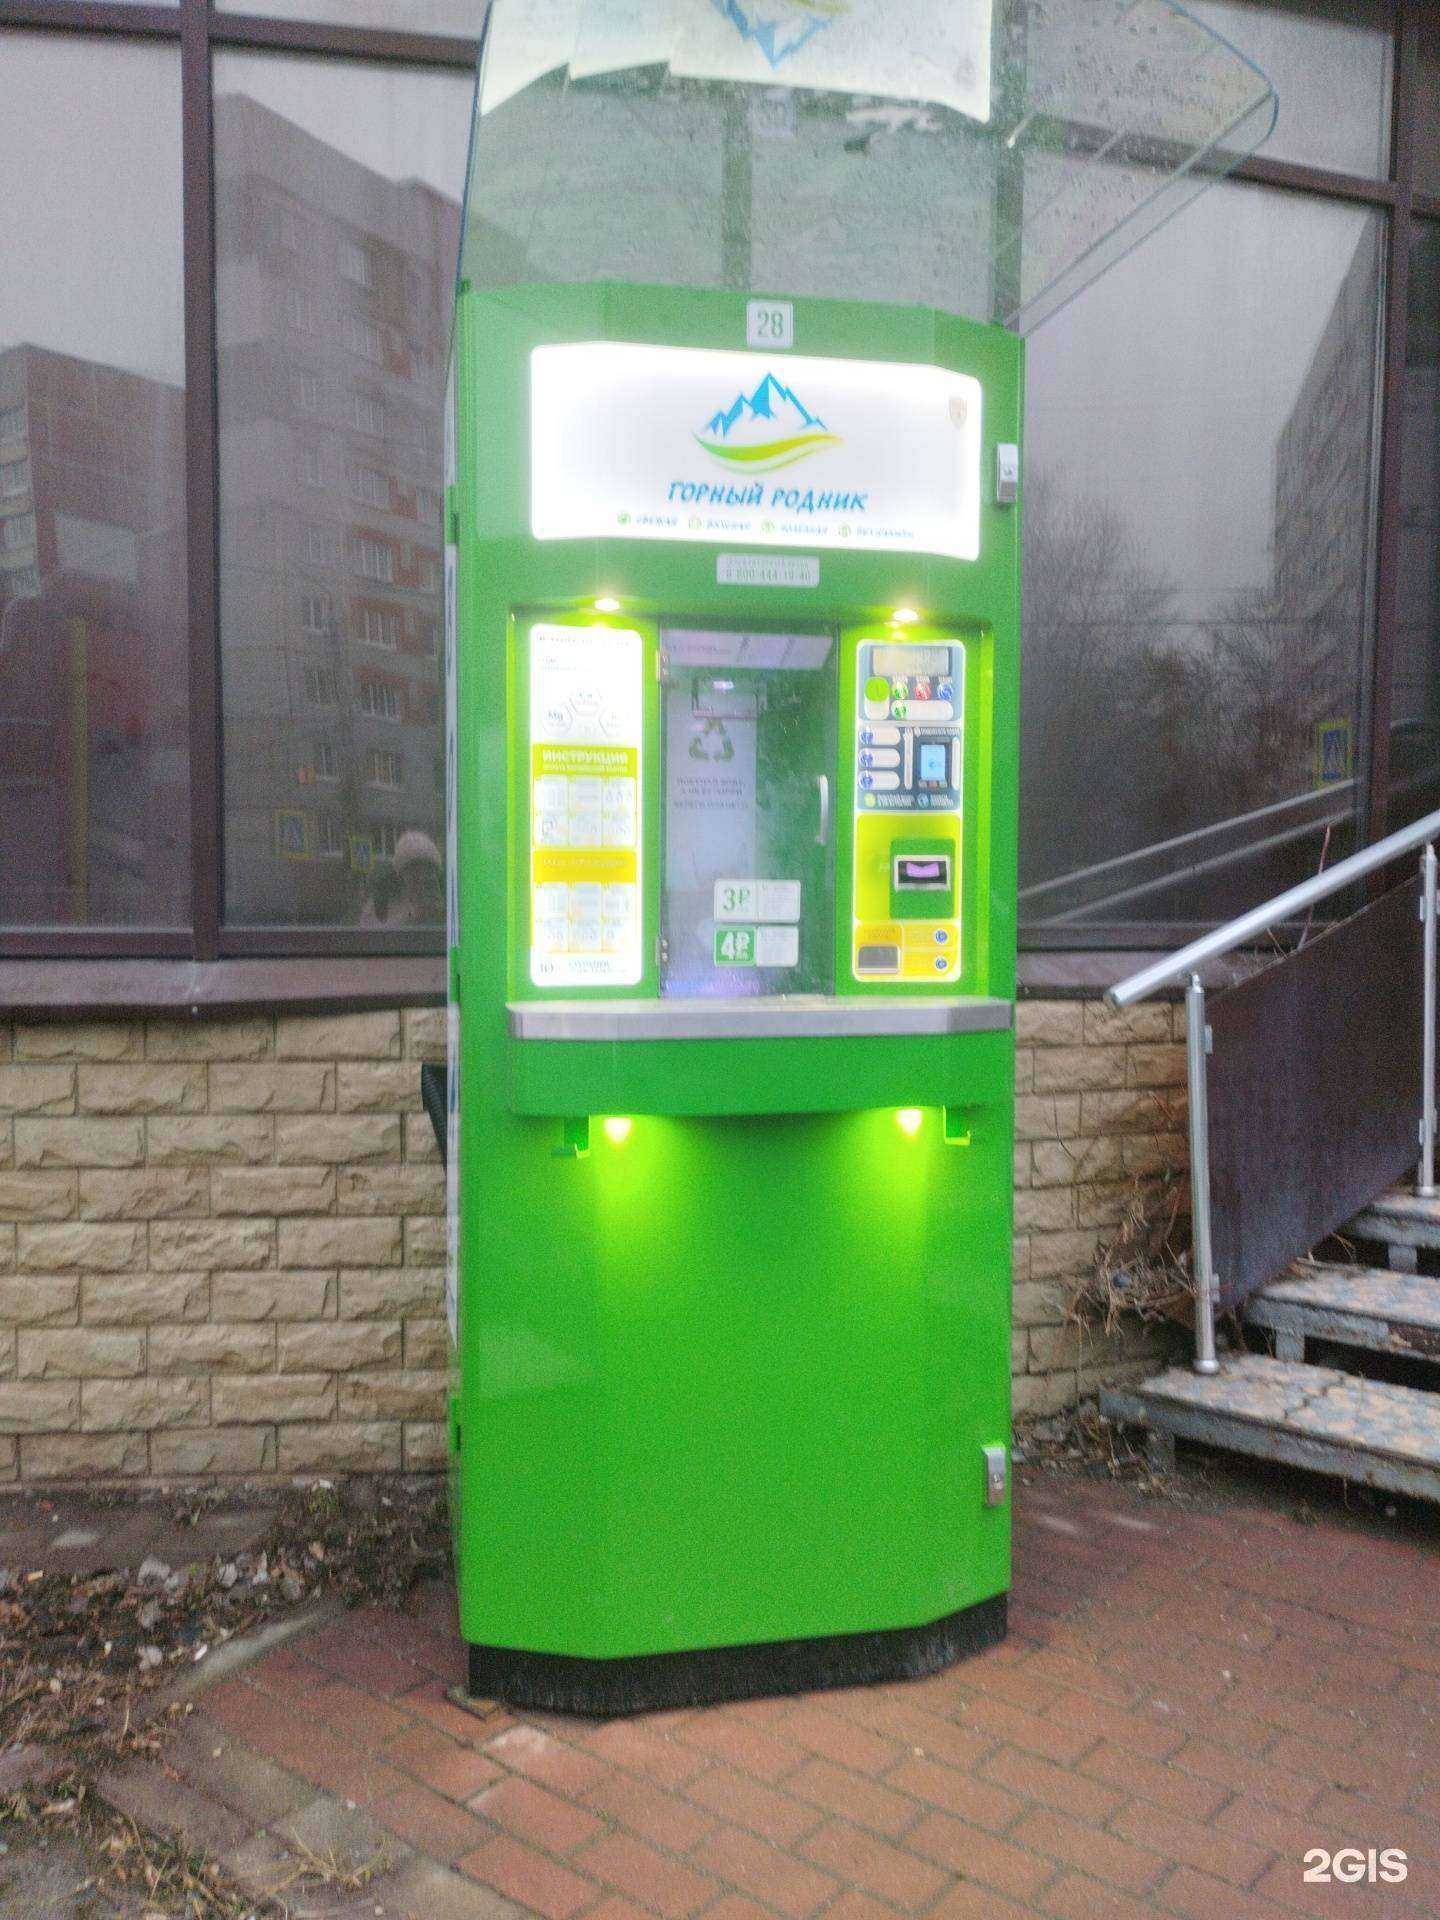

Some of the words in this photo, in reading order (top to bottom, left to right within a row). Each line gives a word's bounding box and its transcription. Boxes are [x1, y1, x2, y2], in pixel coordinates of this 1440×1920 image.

[757, 311, 784, 337] 28
[668, 481, 765, 506] ГОРНЫЙ
[771, 486, 868, 514] РОДНИК
